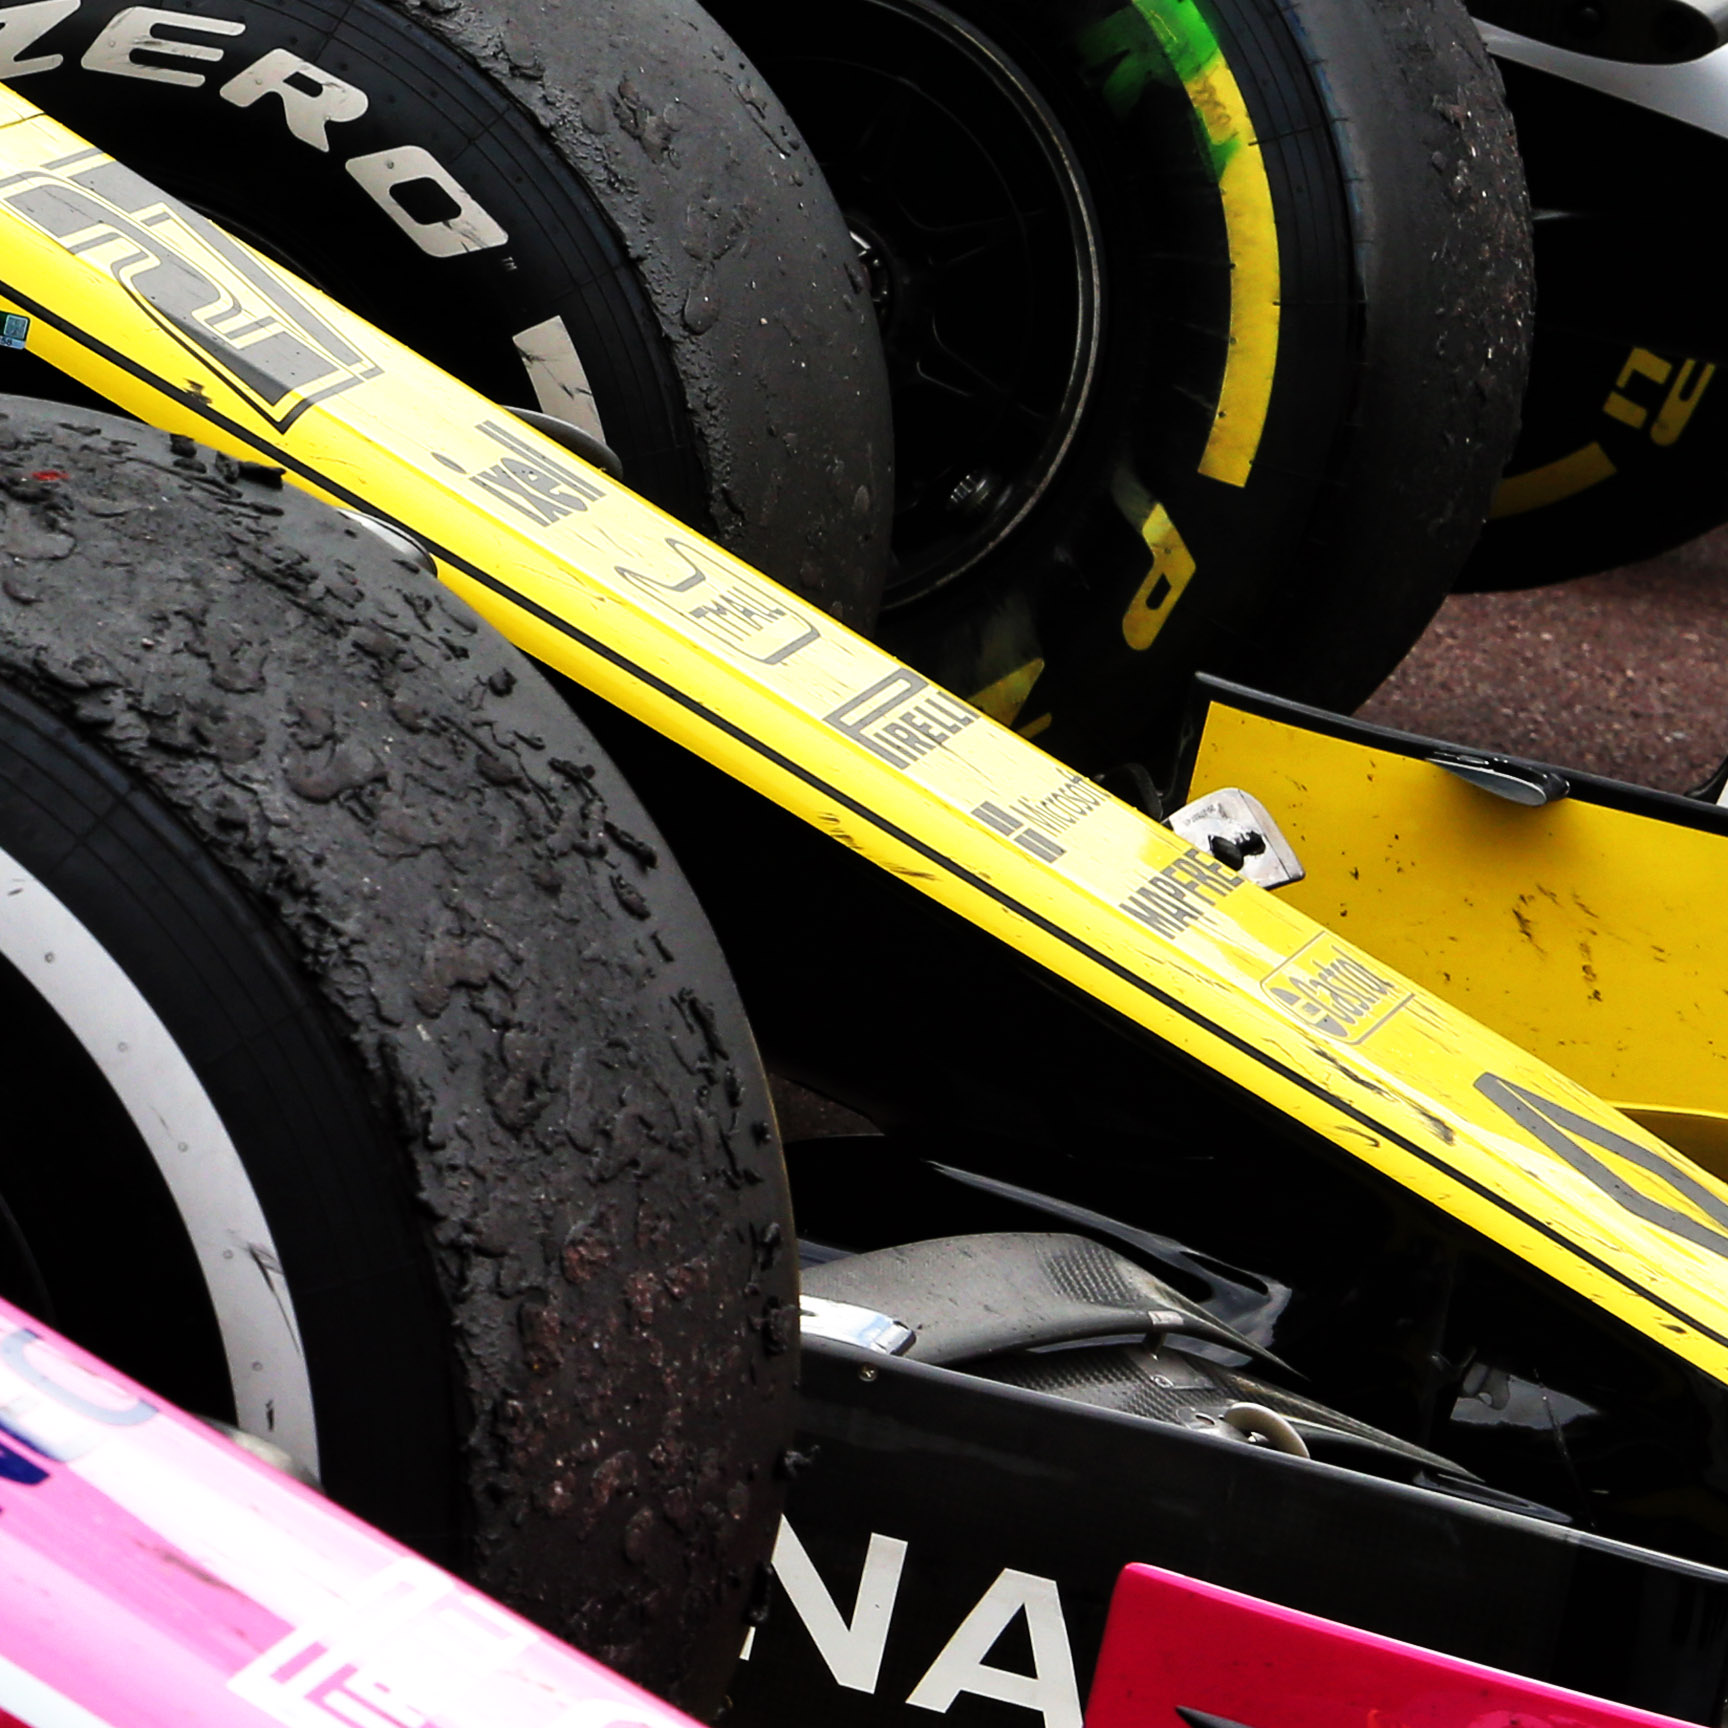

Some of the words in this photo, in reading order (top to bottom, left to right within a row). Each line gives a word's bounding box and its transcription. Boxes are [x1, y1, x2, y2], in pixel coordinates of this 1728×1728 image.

[823, 667, 982, 771] PIRELLI
[1010, 767, 1112, 838] Microsoft
[1119, 848, 1245, 940] MAPFRE
[1295, 940, 1396, 1025] Castrol
